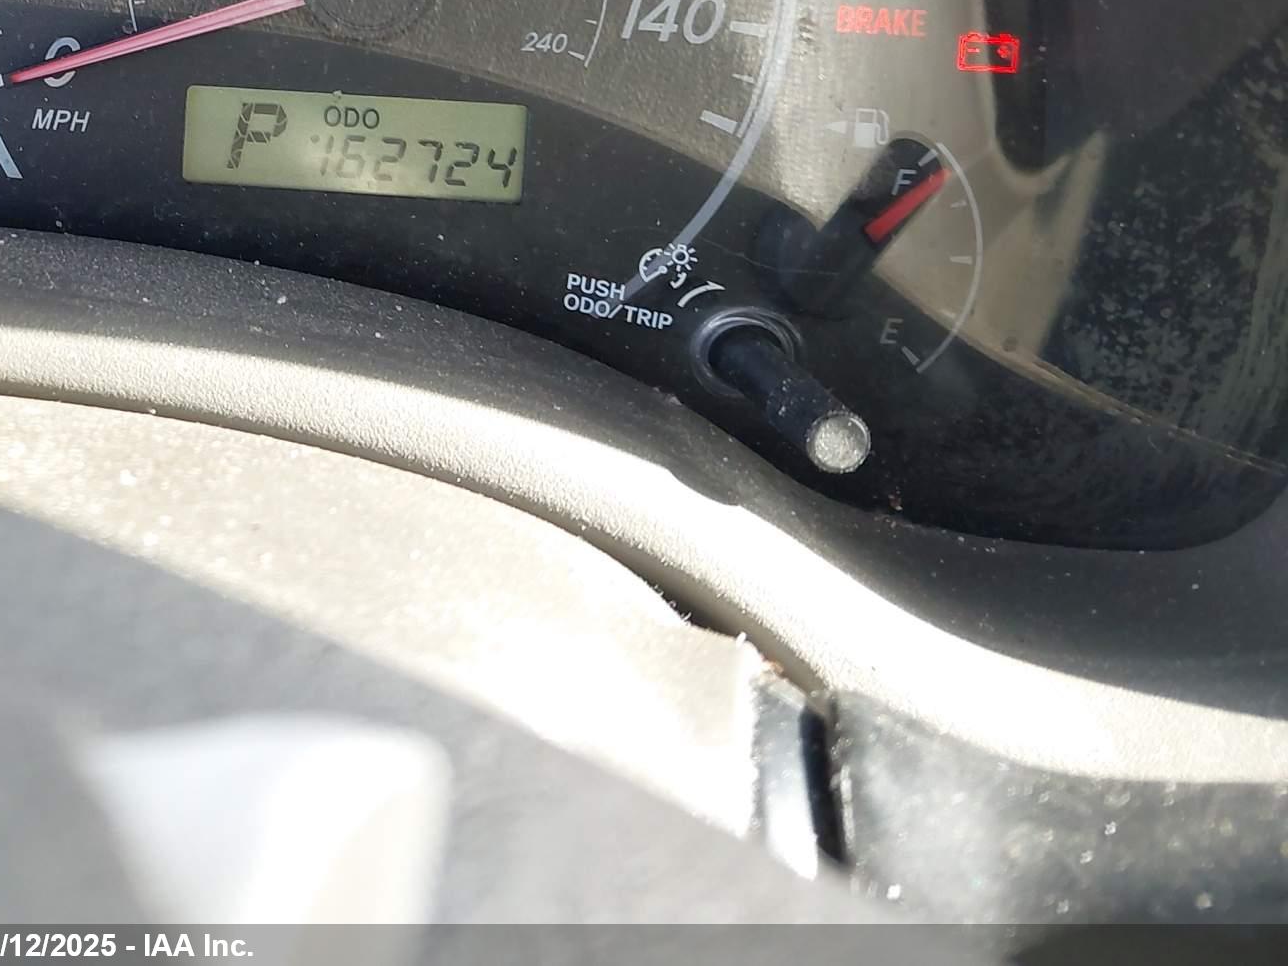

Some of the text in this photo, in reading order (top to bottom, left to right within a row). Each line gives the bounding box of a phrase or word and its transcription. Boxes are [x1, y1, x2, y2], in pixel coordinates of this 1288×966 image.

[836, 5, 927, 37] BRAKE
[521, 34, 568, 55] 240
[32, 109, 90, 133] MPH
[324, 106, 380, 129] ODO
[227, 102, 288, 169] P
[318, 135, 517, 188] 162724
[892, 170, 916, 195] F
[567, 273, 626, 301] PUSH
[563, 293, 673, 331] ODO/TRIP
[879, 319, 905, 345] E
